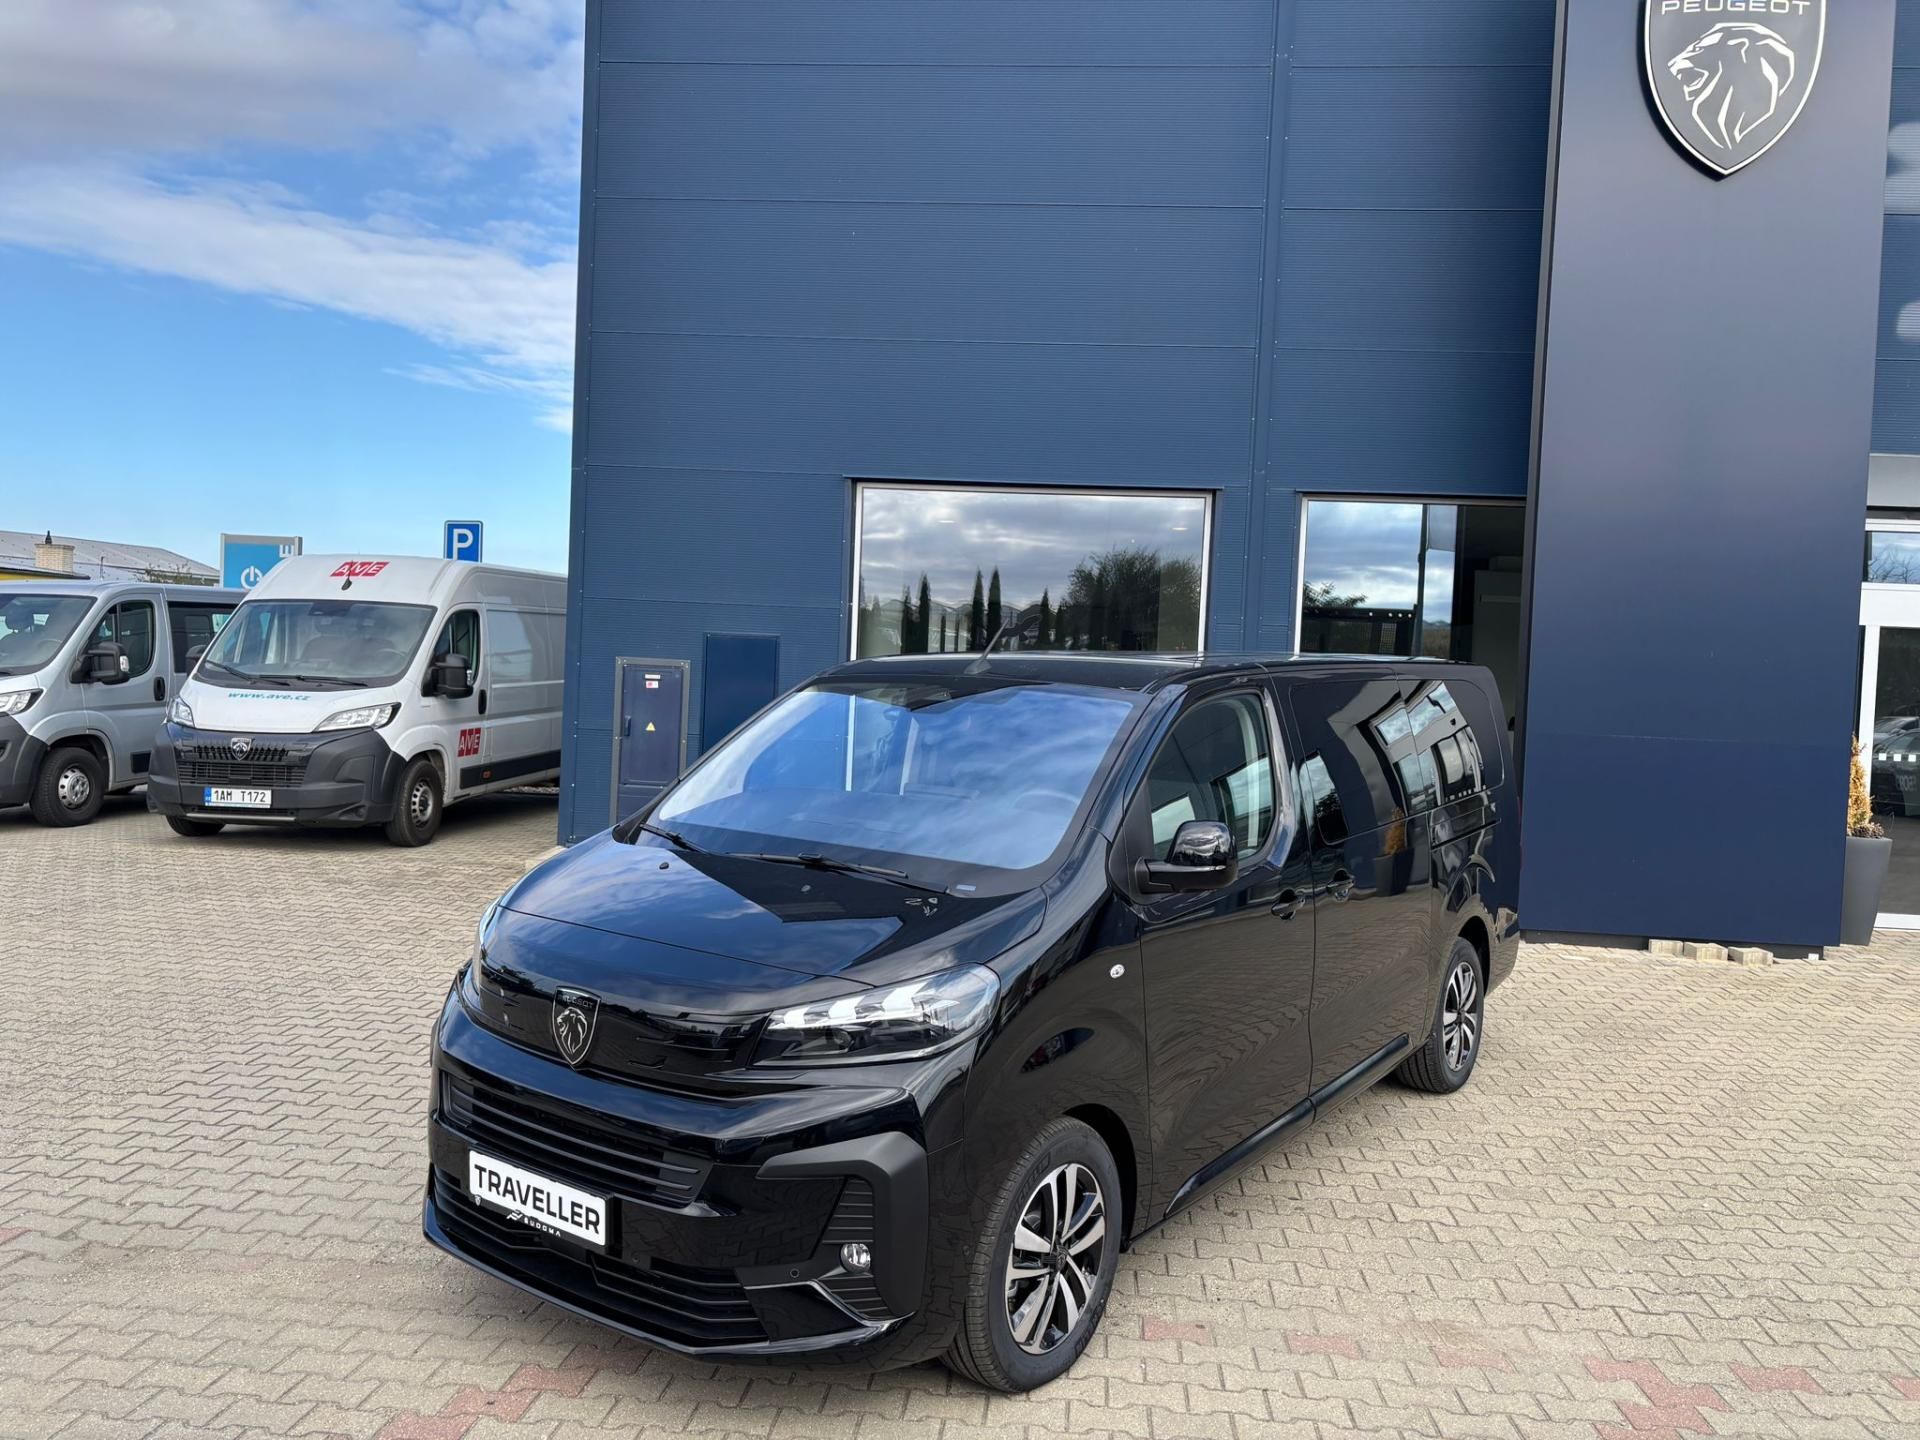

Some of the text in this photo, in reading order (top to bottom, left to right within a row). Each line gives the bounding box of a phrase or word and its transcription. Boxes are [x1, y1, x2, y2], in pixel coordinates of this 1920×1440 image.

[1662, 0, 1810, 15] PEUGEOT
[453, 528, 473, 560] P
[333, 563, 384, 575] AVE
[228, 693, 311, 701] www.ave.cz
[459, 731, 481, 752] AVE
[240, 791, 266, 803] T172
[474, 1164, 600, 1234] TRAVELLER
